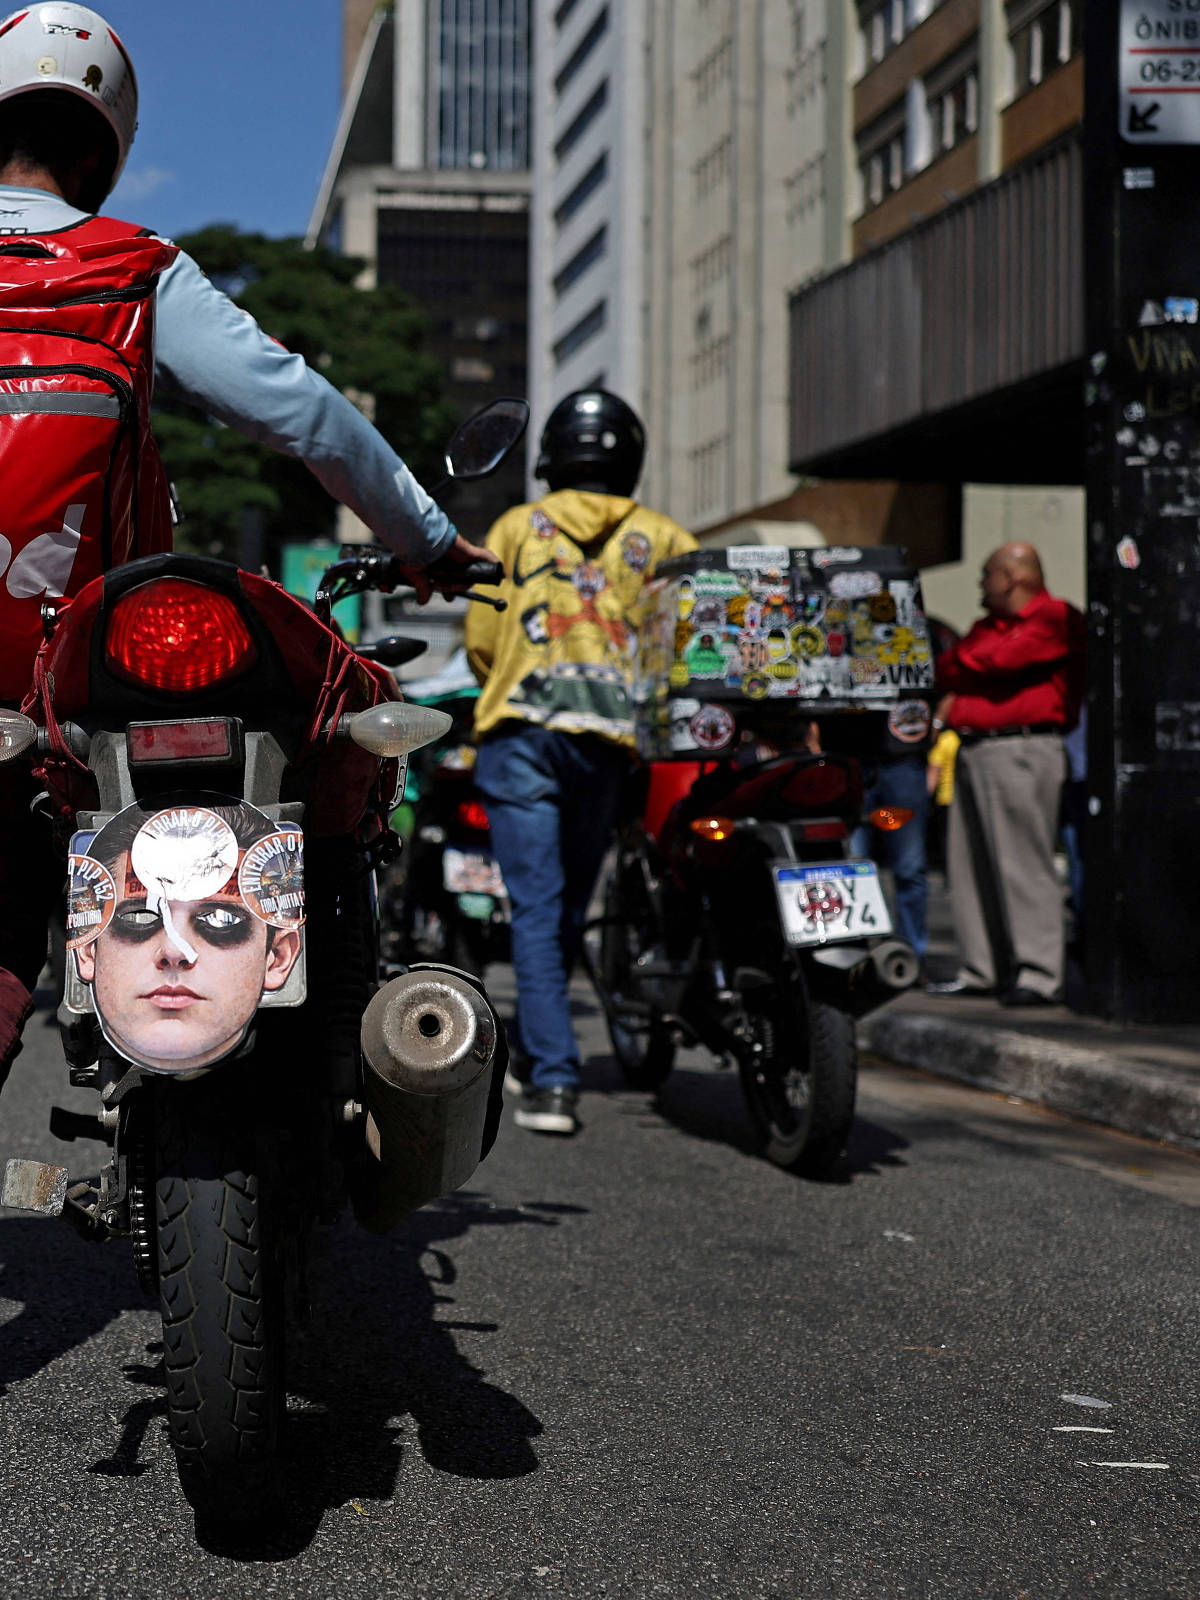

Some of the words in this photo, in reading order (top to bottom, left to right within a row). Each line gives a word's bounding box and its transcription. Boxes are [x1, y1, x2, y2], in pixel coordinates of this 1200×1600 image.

[1140, 60, 1200, 82] 06-2
[77, 860, 104, 882] PLP
[92, 878, 115, 902] 152
[241, 837, 285, 895] ENTERRAR
[287, 835, 296, 852] O
